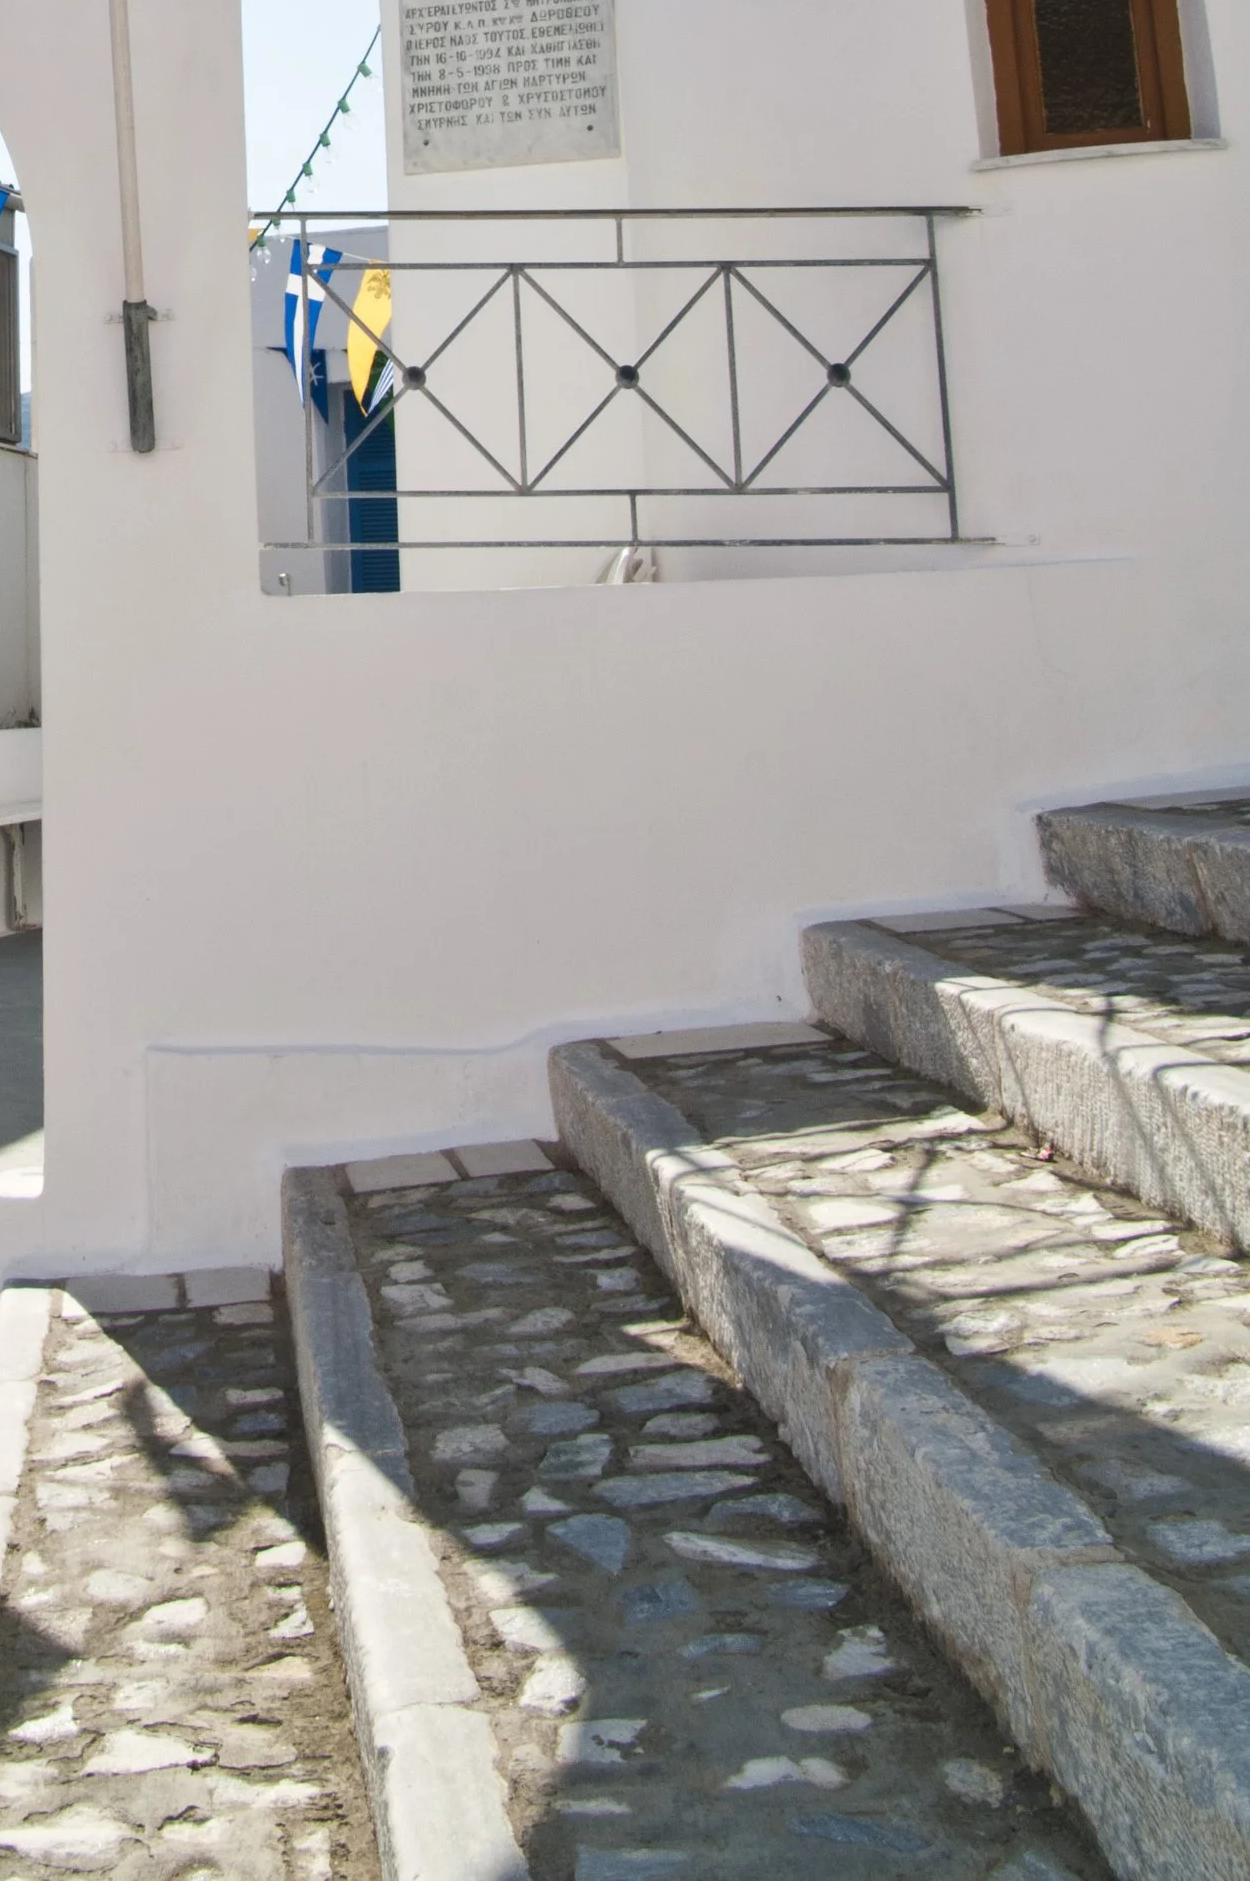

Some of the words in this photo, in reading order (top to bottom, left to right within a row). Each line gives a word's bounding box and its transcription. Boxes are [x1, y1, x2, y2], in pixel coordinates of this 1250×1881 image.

[409, 20, 450, 35] ΣΥΡΟΥ
[530, 5, 600, 22] ΔΩΡΟΘΕΟΥ
[450, 33, 478, 46] ΝΑΟΣ
[409, 54, 430, 66] ΤΗΝ
[507, 45, 525, 57] ΚΑΙ
[410, 70, 432, 82] ΤΗΝ
[507, 59, 537, 73] ΠΡΟΣ
[544, 57, 571, 69] ΤΙΜΗ
[576, 54, 596, 66] ΚΑΙ
[412, 84, 450, 98] ΜΝΗΜΗ
[457, 81, 479, 94] ΤΩΝ
[484, 77, 517, 91] ΑΓΙΩΝ
[523, 71, 586, 87] ΜΑΡΤΥΡΩΝ
[409, 97, 492, 115] ΧΡΙΣΤΟΦΟΡΟΥ
[518, 86, 606, 105] ΧΡΥΣΟΣΤΟΜΟΥ
[417, 115, 468, 130] ΣΜΥΡΝΗΣ
[476, 113, 494, 125] ΚΑΙ
[500, 111, 522, 122] ΤΩΝ
[528, 108, 551, 119] ΣΥΝ
[559, 104, 597, 117] ΑΥΤΩΝ
